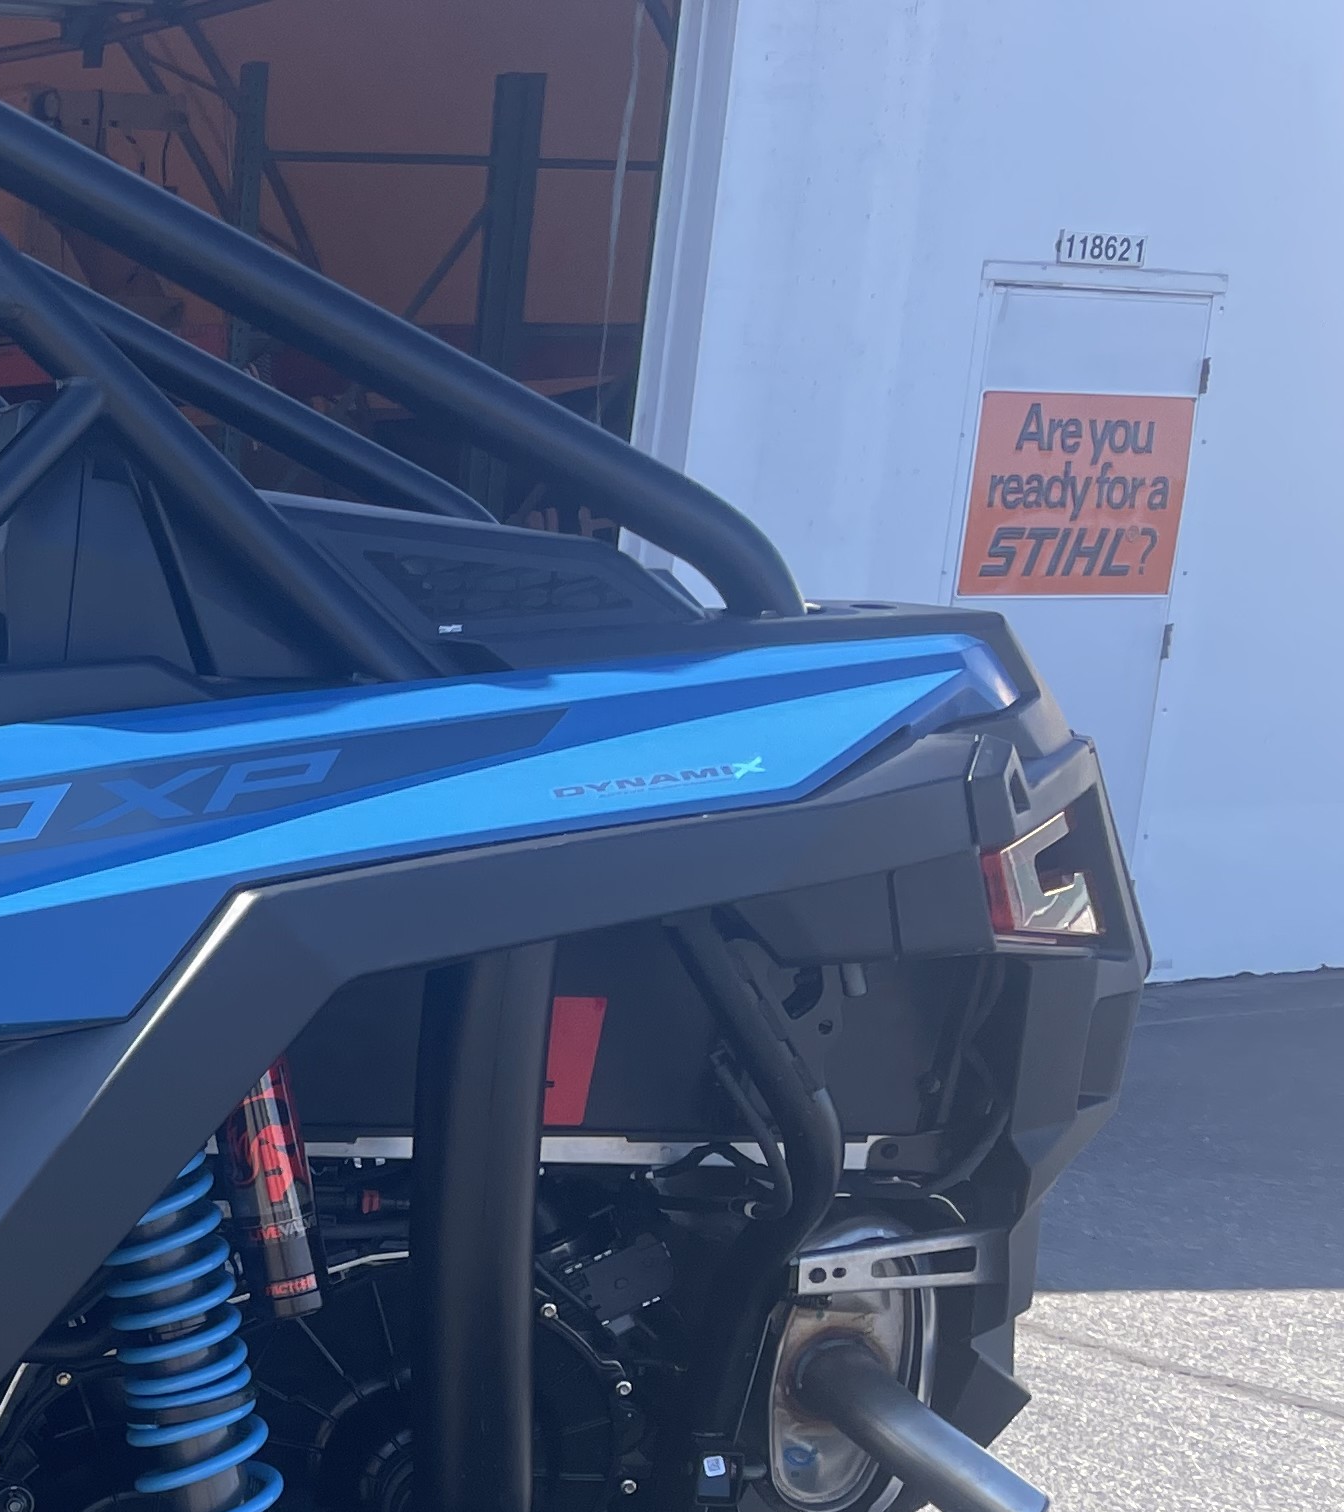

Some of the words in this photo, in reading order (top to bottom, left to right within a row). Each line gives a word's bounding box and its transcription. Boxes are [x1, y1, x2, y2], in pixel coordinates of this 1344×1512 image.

[1066, 234, 1145, 263] 118621
[1015, 402, 1083, 453] Are
[1089, 418, 1156, 466] you
[987, 460, 1093, 522] ready
[1095, 461, 1146, 509] for
[1147, 475, 1170, 510] a
[72, 748, 344, 832] XP
[552, 756, 766, 799] DYNAMIX
